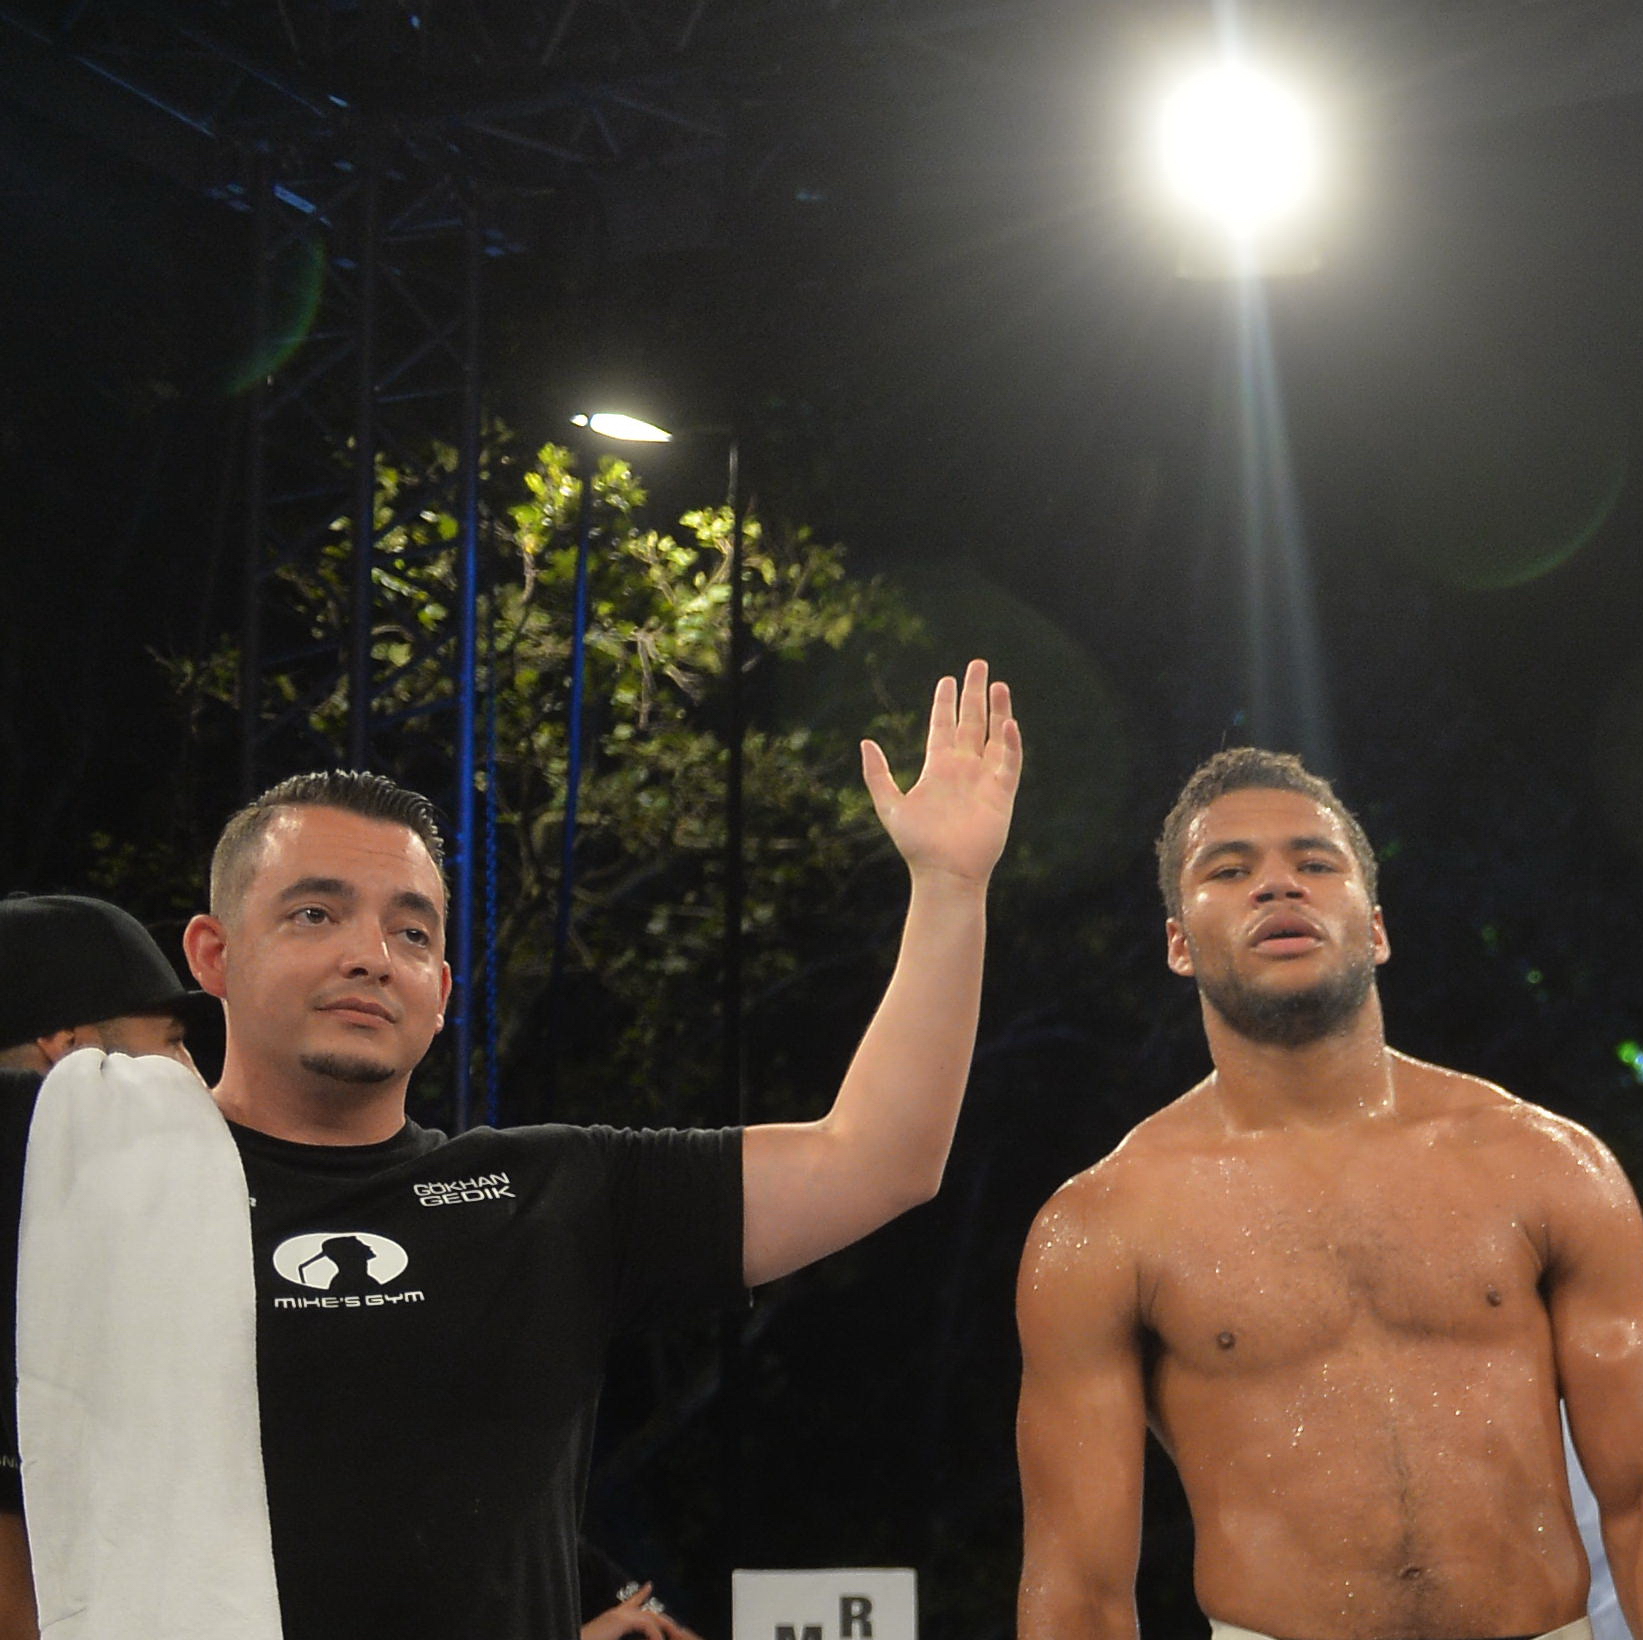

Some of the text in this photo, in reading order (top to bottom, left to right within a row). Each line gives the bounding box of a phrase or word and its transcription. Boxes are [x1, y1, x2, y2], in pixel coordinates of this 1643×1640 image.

[419, 1185, 516, 1208] GEDIK
[274, 1290, 425, 1309] MIKE'S GYM
